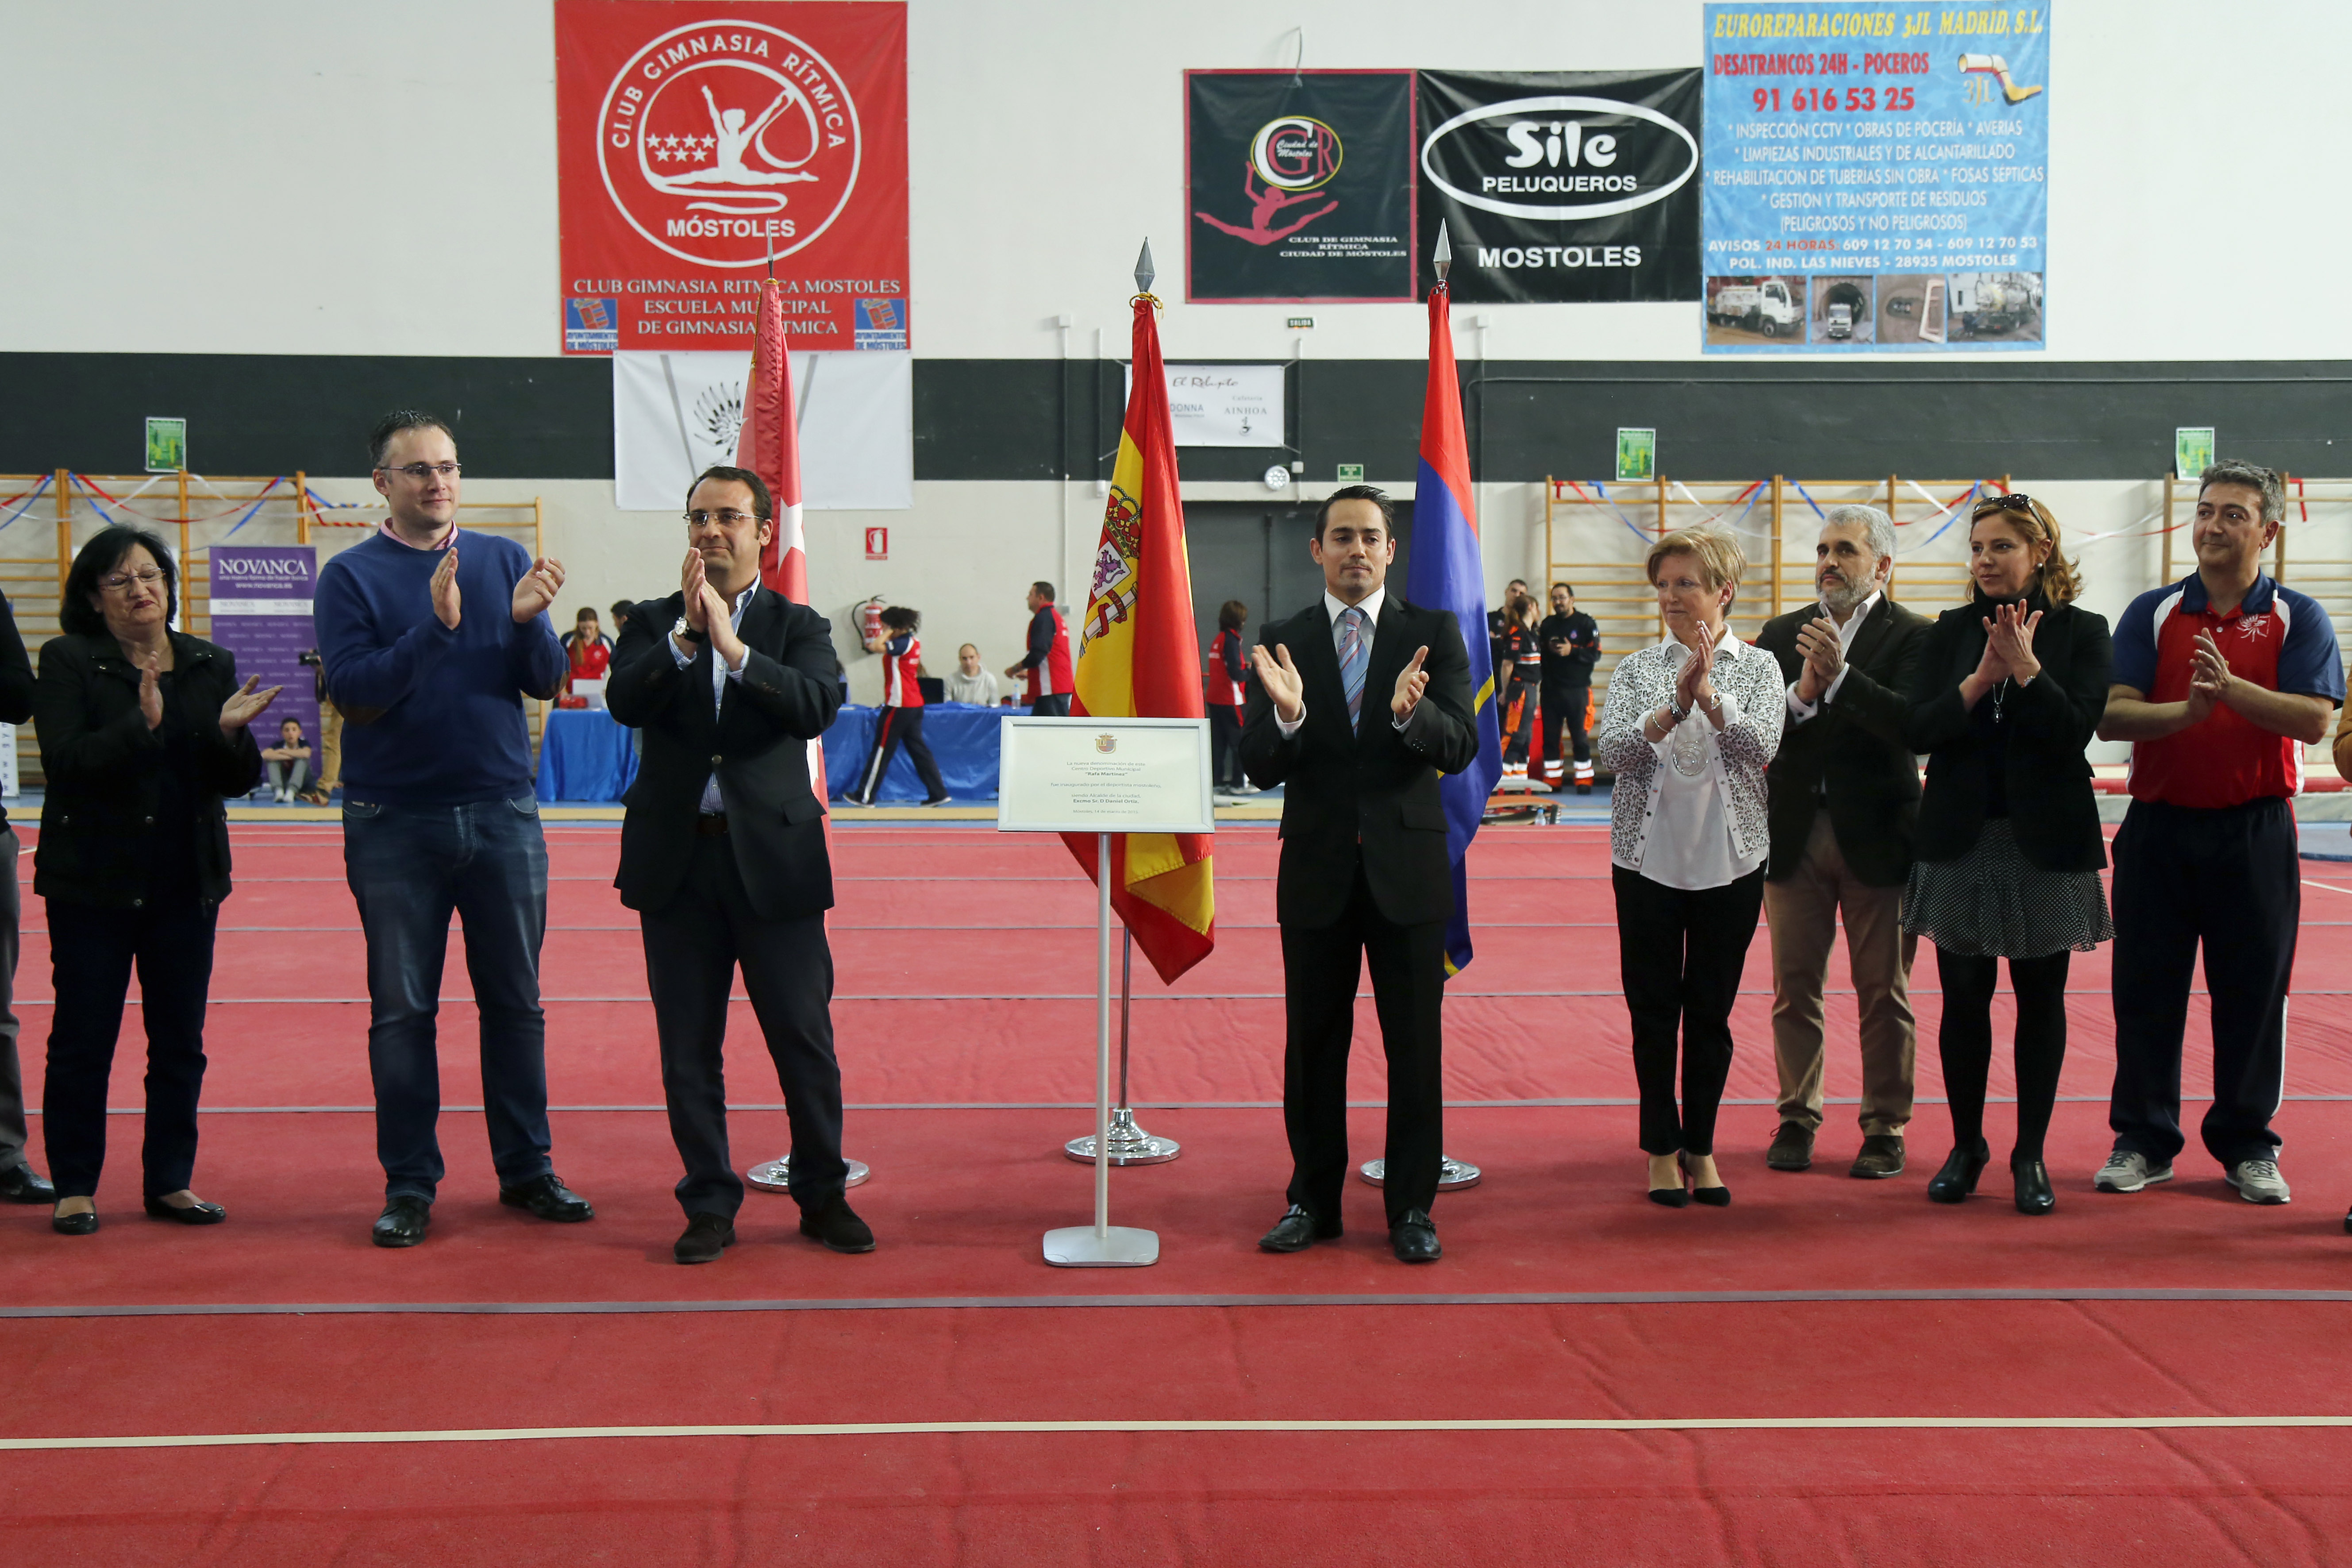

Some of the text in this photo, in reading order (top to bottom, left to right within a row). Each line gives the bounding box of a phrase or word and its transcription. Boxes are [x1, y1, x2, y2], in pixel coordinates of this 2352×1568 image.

[1714, 10, 2043, 39] EUROREPARACIONES 3JL MADRID, S.L.
[1714, 53, 1814, 76] DESATRANCOS
[1819, 53, 1848, 75] 24H
[1864, 52, 1929, 75] POCEROS
[612, 35, 846, 149] CLUB GIMNASIA RÍTMICA
[1753, 86, 1915, 112] 91 616 53 25
[1963, 76, 1995, 109] 3JL
[1736, 118, 2023, 139] INSPECCIÓN CCTV OBRAS DE POCERÍA AVERIAS
[1505, 120, 1617, 168] Sile
[1743, 143, 2015, 162] LIMPIEZAS INDUSTRIALES Y DE ALCANTARILLADO
[1482, 175, 1637, 193] PELUQUEROS
[1713, 164, 2044, 185] REHABILITACIÓN DE TUBERÍAS SIN OBRA FOSAS SÉPTICAS
[1770, 190, 1987, 208] GESTION Y TRANSPORTE DE RESIDUOS
[667, 215, 795, 238] MÓSTOLES
[1781, 214, 1967, 235] (PELIGROSOS Y NO PELIGROSOS)
[1708, 240, 1760, 252] AVISOS
[1765, 240, 1782, 251] 24
[1786, 239, 1840, 251] HORAS:
[1843, 239, 1868, 251] 609
[1874, 238, 1890, 250] 12
[1895, 238, 1912, 250] 70
[1916, 238, 1932, 250] 54
[1948, 237, 1973, 250] 609
[1979, 237, 1994, 249] 12
[1999, 236, 2017, 249] 70
[2020, 236, 2037, 249] 53
[1478, 246, 1641, 268] MOSTOLES
[1729, 257, 1762, 269] POL.
[1767, 257, 1796, 269] IND.
[1802, 257, 1826, 268] LAS
[1831, 256, 1880, 268] NIEVES
[1894, 255, 1938, 268] 28935
[1942, 254, 2017, 266] MOSTOLES
[574, 279, 901, 294] CLUB GIMNASIA RITMCA MOSTOLES
[644, 300, 832, 314] ESCUELA MUCIPAL
[638, 320, 662, 334] DE
[666, 320, 756, 335] GIMNASIA
[219, 559, 309, 575] NOVANCA
